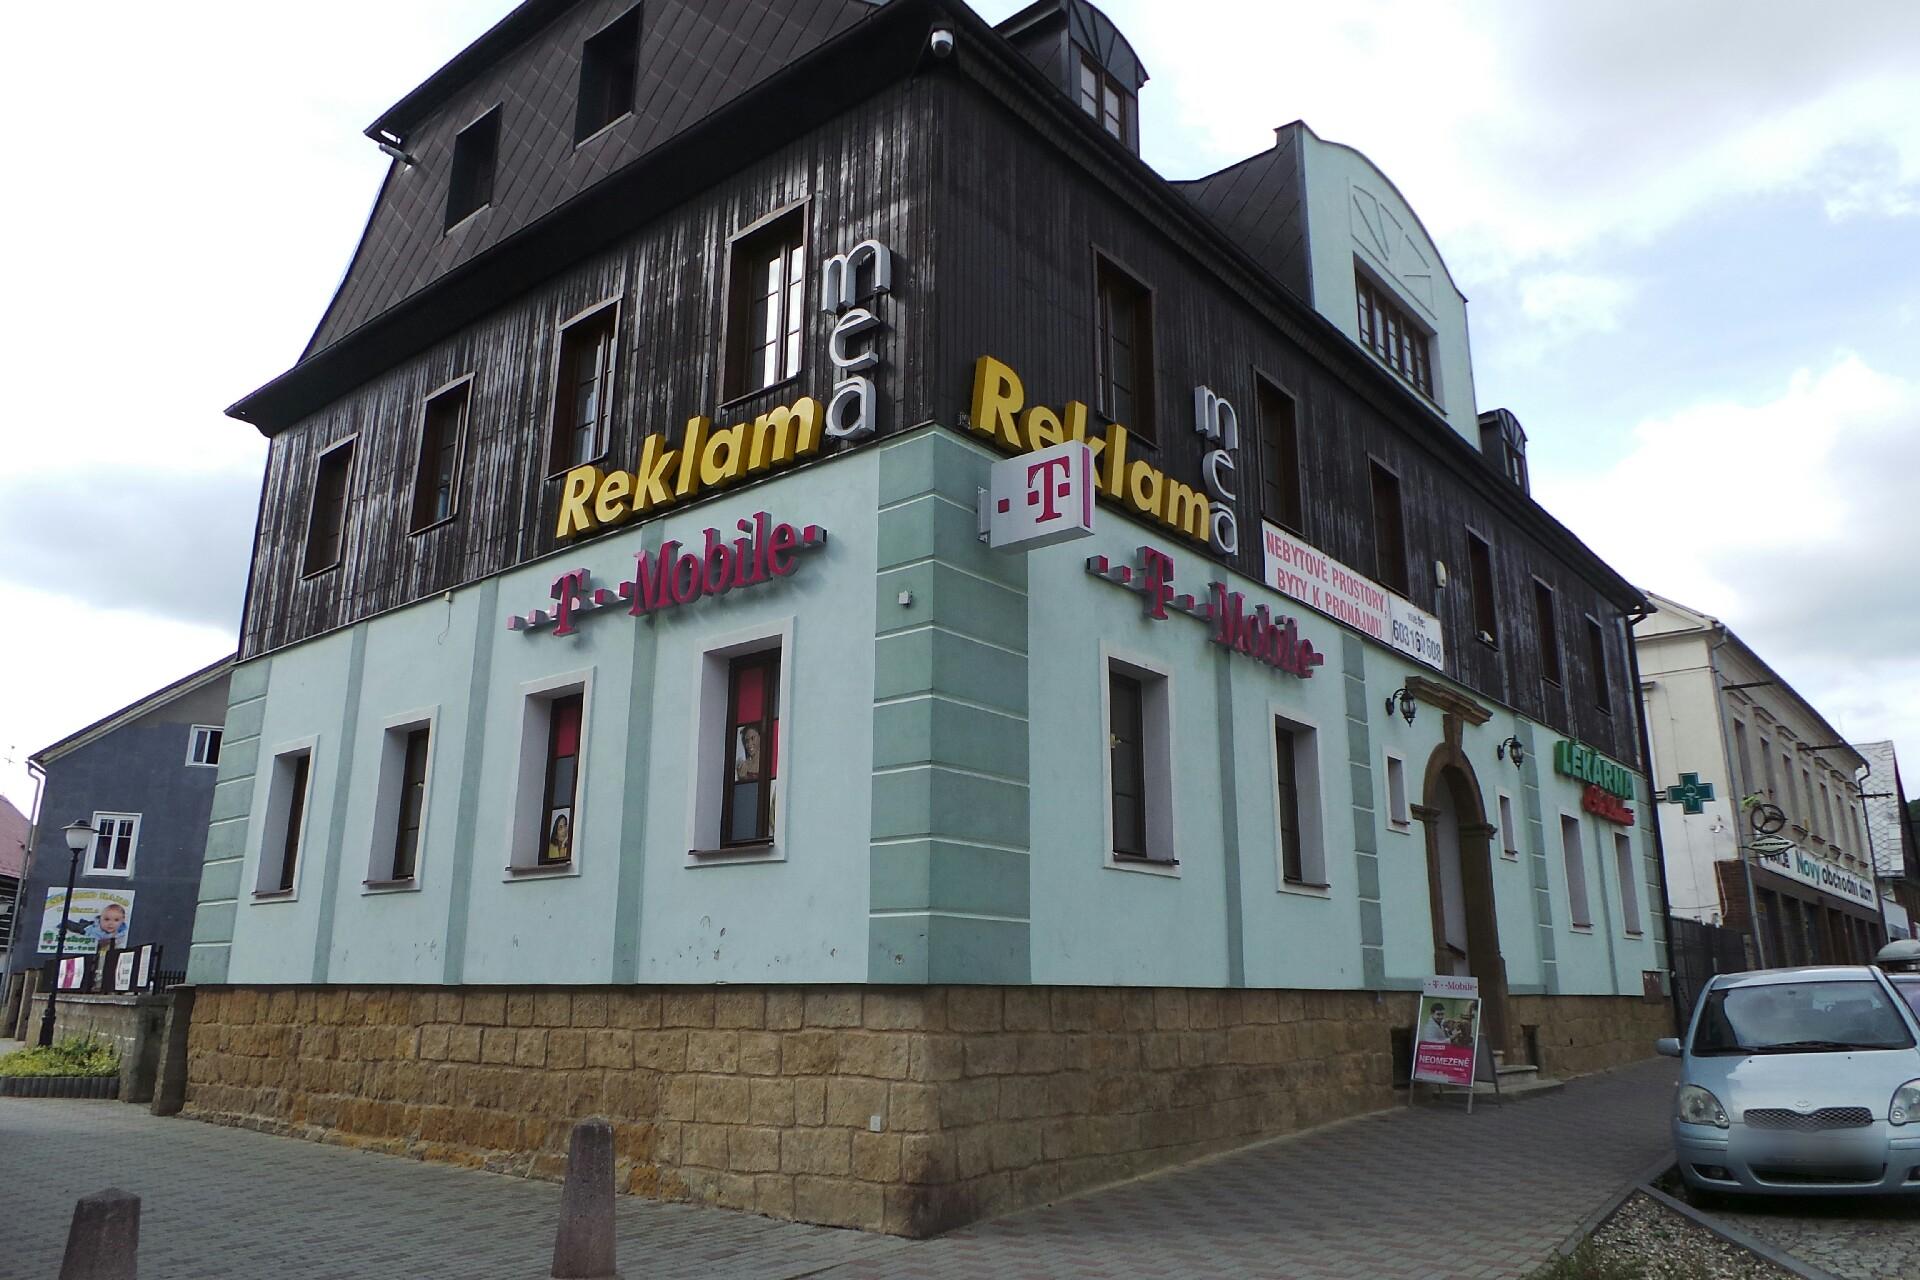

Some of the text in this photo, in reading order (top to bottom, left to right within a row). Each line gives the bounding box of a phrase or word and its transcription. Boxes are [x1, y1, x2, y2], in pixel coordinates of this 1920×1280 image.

[1265, 530, 1329, 584] NEBYTOVÉ
[1277, 567, 1308, 599] BYTY
[1312, 584, 1321, 609] K
[1325, 591, 1383, 638] PRONÁJMU
